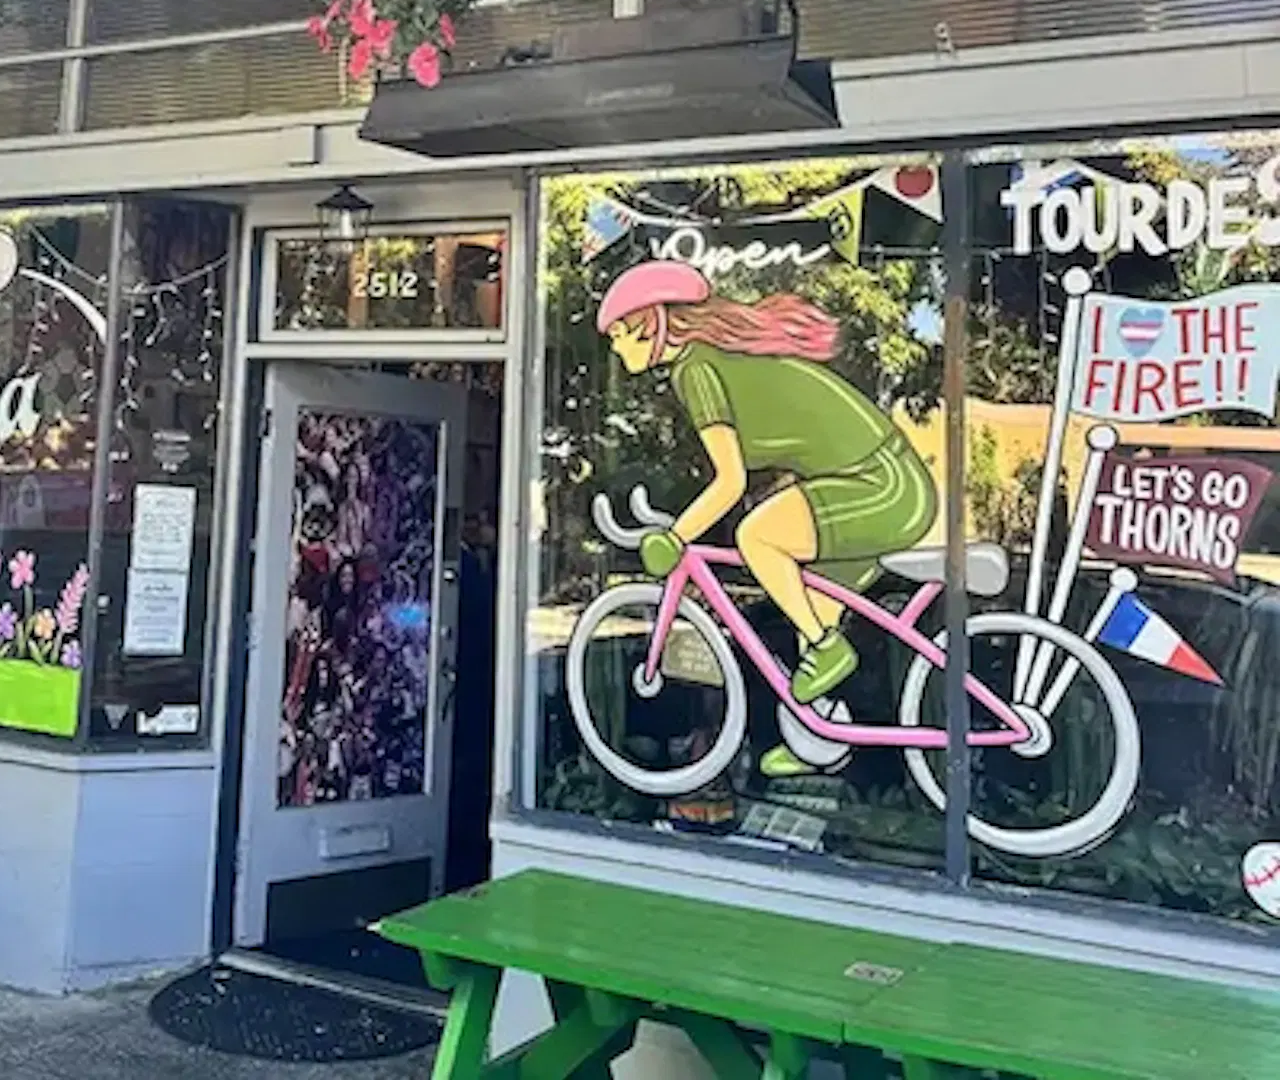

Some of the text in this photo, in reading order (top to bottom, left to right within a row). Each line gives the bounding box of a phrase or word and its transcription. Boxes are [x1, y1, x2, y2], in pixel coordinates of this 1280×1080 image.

[1000, 178, 1169, 256] TOUR
[1167, 174, 1250, 250] DE
[352, 271, 420, 298] 2512
[649, 227, 832, 285] Open
[1092, 301, 1260, 355] I THE
[1083, 356, 1249, 415] FIRE!!
[1112, 463, 1249, 509] LET'S GO
[1095, 493, 1240, 570] THORNS
